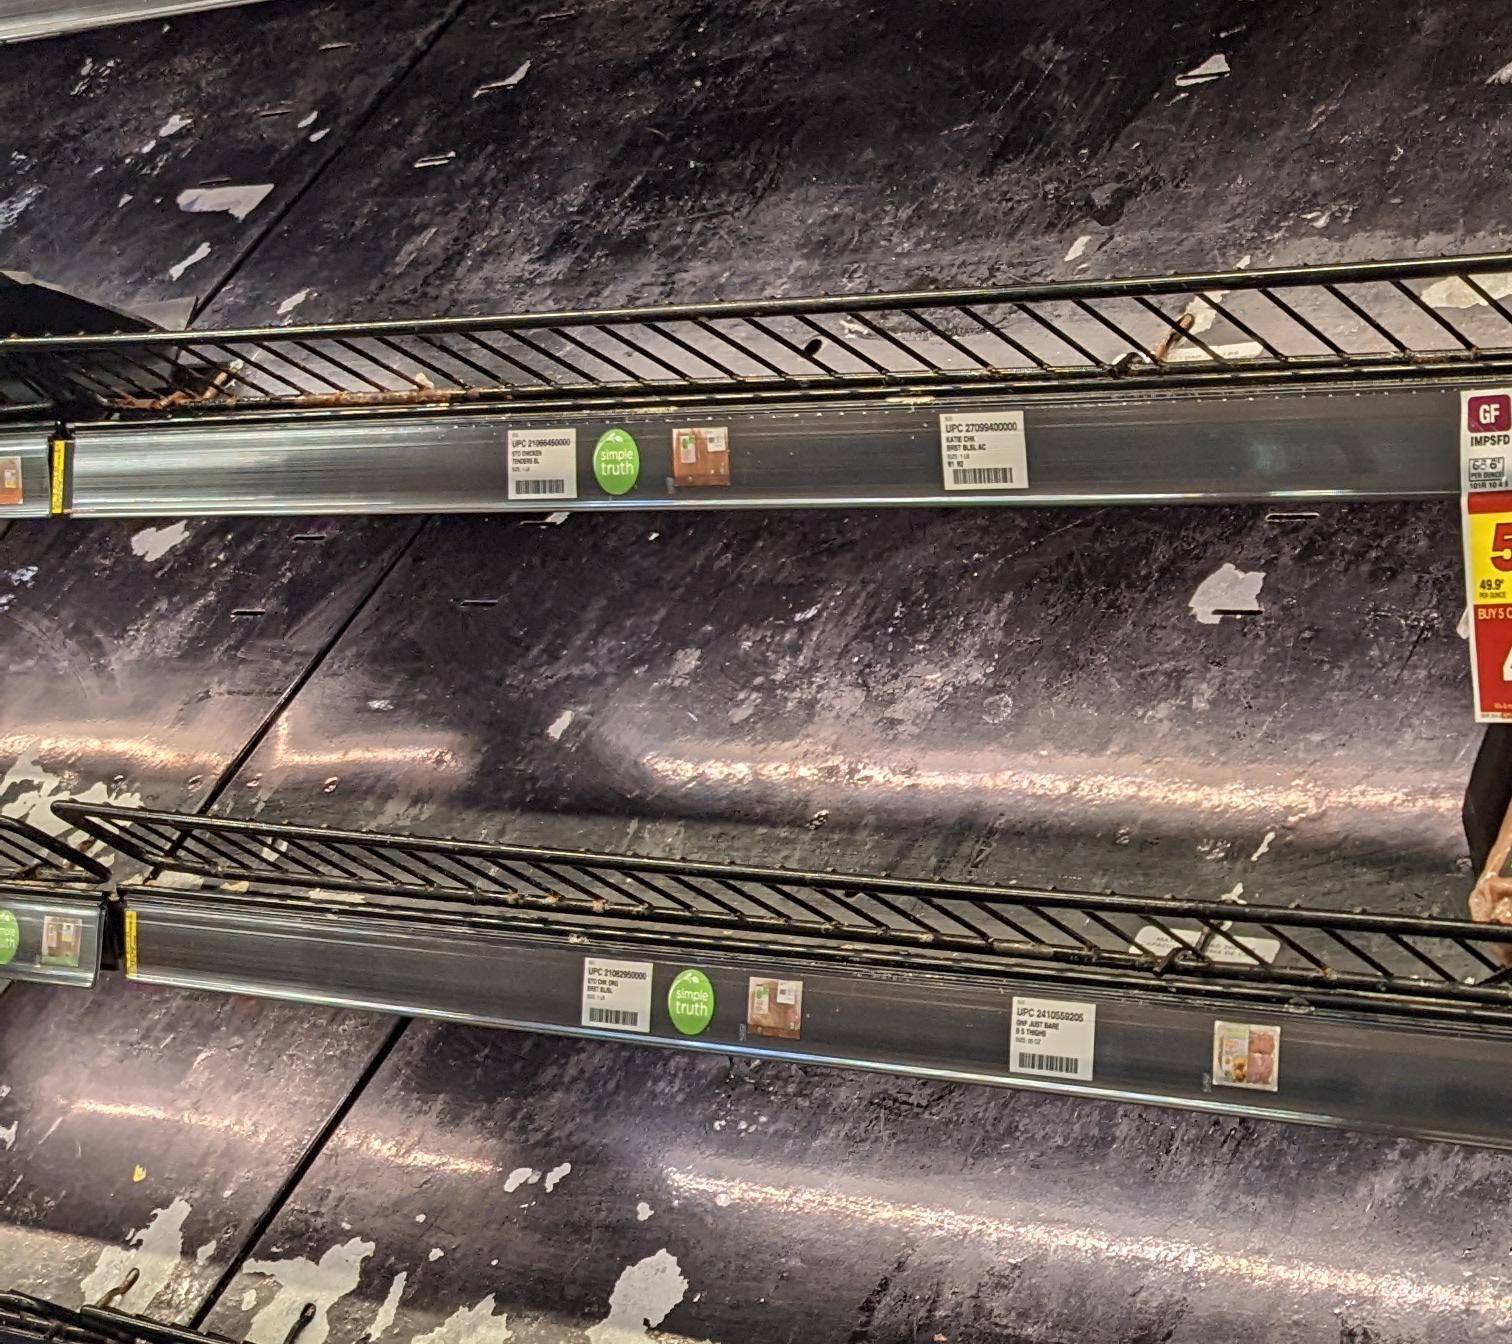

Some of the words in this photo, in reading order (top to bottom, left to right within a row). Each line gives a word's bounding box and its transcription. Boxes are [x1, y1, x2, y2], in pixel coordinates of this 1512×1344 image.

[1479, 405, 1500, 424] GF
[945, 425, 963, 433] UPC
[1470, 433, 1510, 447] IMPSFD
[601, 450, 633, 461] simple
[601, 462, 634, 475] truth
